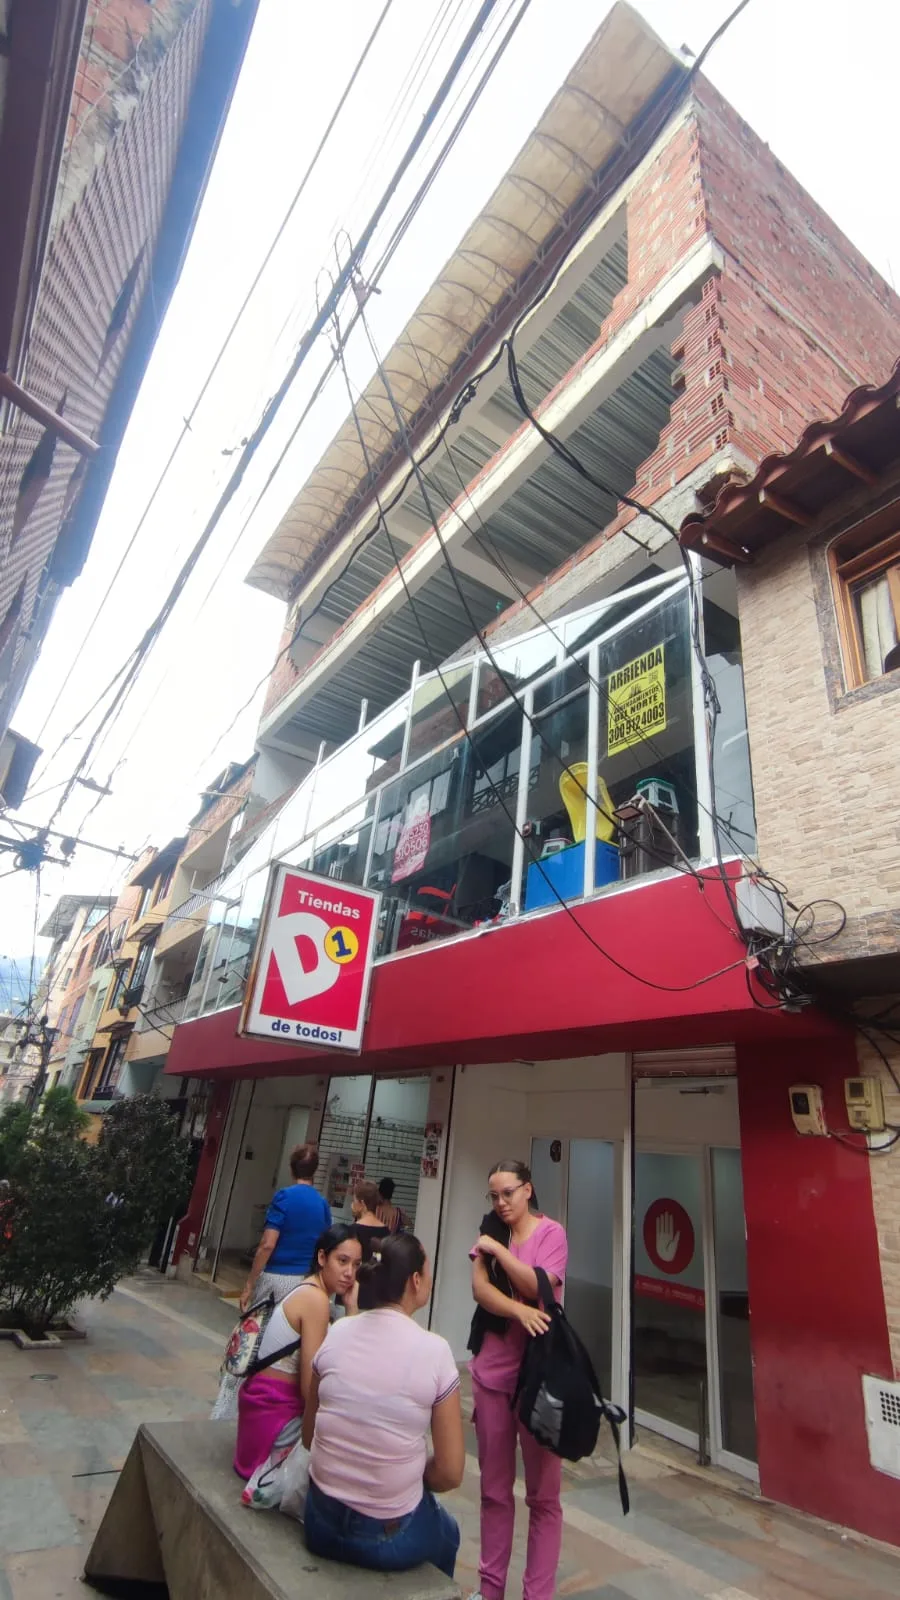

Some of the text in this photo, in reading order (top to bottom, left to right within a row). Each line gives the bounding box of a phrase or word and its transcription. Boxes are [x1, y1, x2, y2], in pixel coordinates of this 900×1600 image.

[609, 647, 663, 693] ARRIENDA
[630, 692, 658, 714] NORTE
[297, 890, 361, 920] Tiendas
[271, 1019, 342, 1042] de todos!
